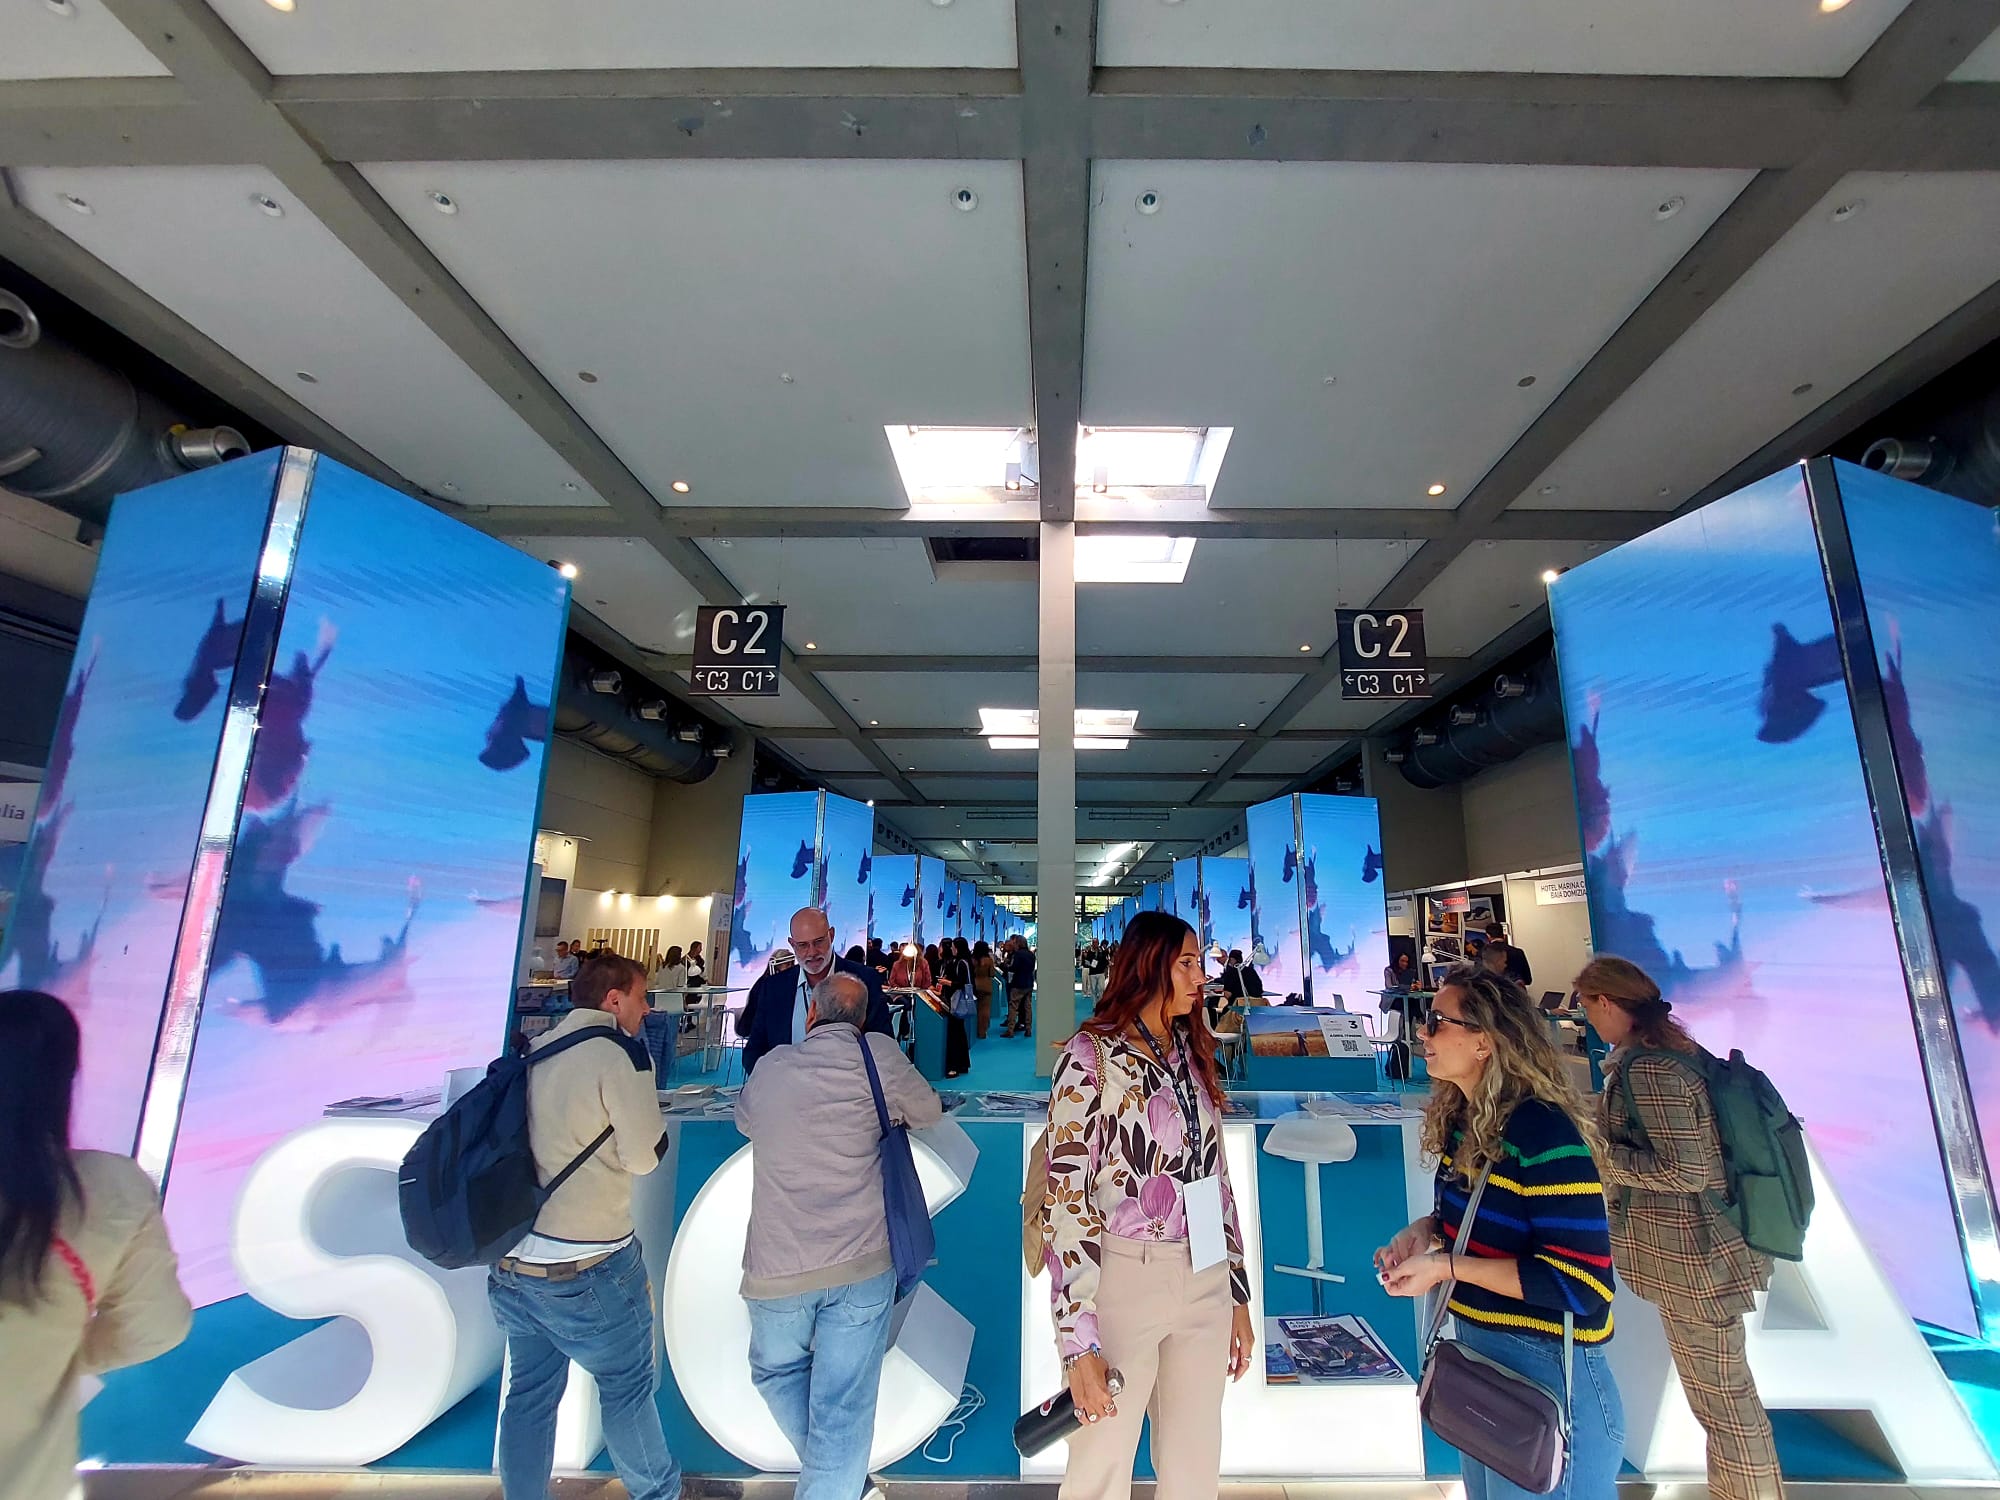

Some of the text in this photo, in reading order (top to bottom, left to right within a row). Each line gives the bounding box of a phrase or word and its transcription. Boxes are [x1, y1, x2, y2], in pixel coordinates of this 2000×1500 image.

[711, 609, 769, 655] C2
[1353, 613, 1412, 658] C2
[706, 670, 763, 691] C3 C1
[1357, 674, 1414, 694] C3 C1
[0, 803, 25, 820] lia
[1540, 884, 1558, 892] HOTEL
[1558, 882, 1580, 890] MARINA
[1550, 891, 1562, 899] BAIA
[1347, 1020, 1358, 1029] 3
[186, 1115, 2000, 1478] SCLA
